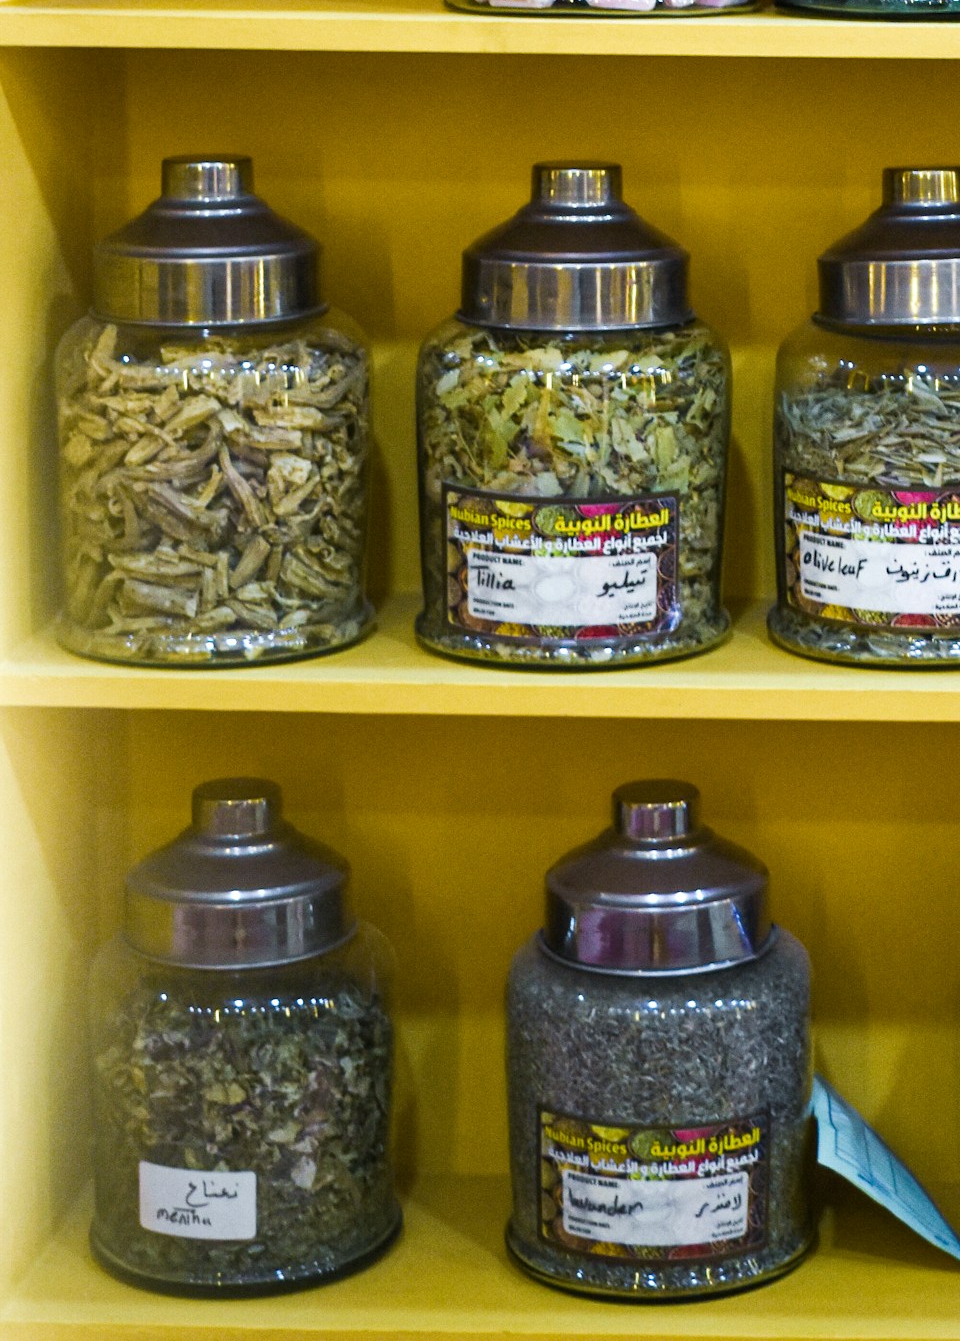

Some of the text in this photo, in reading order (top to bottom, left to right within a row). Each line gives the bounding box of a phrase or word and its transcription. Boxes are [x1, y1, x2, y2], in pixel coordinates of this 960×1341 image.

[818, 498, 852, 514] Spices
[872, 502, 927, 521] النوبية
[491, 514, 531, 531] Spices
[555, 510, 669, 534] العطارة النوبية
[587, 1138, 627, 1156] Spices
[651, 1128, 760, 1159] العطارة النوبية
